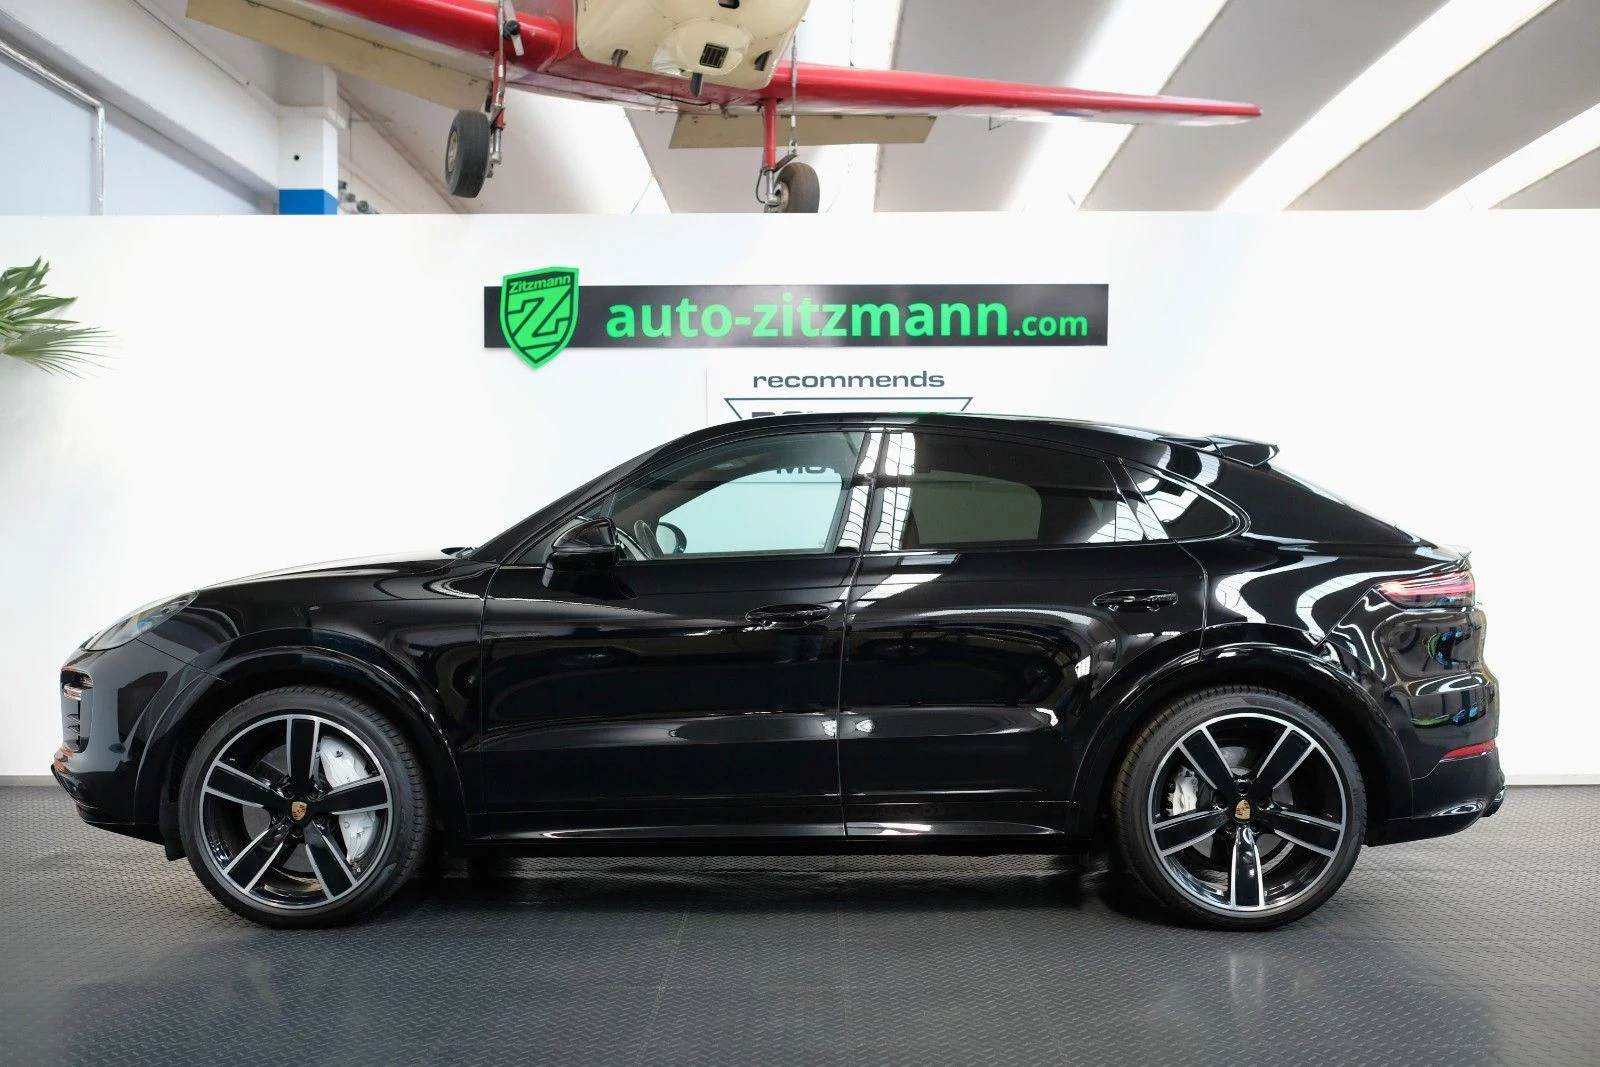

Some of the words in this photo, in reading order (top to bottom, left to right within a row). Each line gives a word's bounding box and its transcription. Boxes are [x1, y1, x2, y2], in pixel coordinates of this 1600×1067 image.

[509, 275, 571, 294] Zitzmann
[606, 292, 1088, 338] auto-zitzmann.com
[753, 370, 945, 389] recommends
